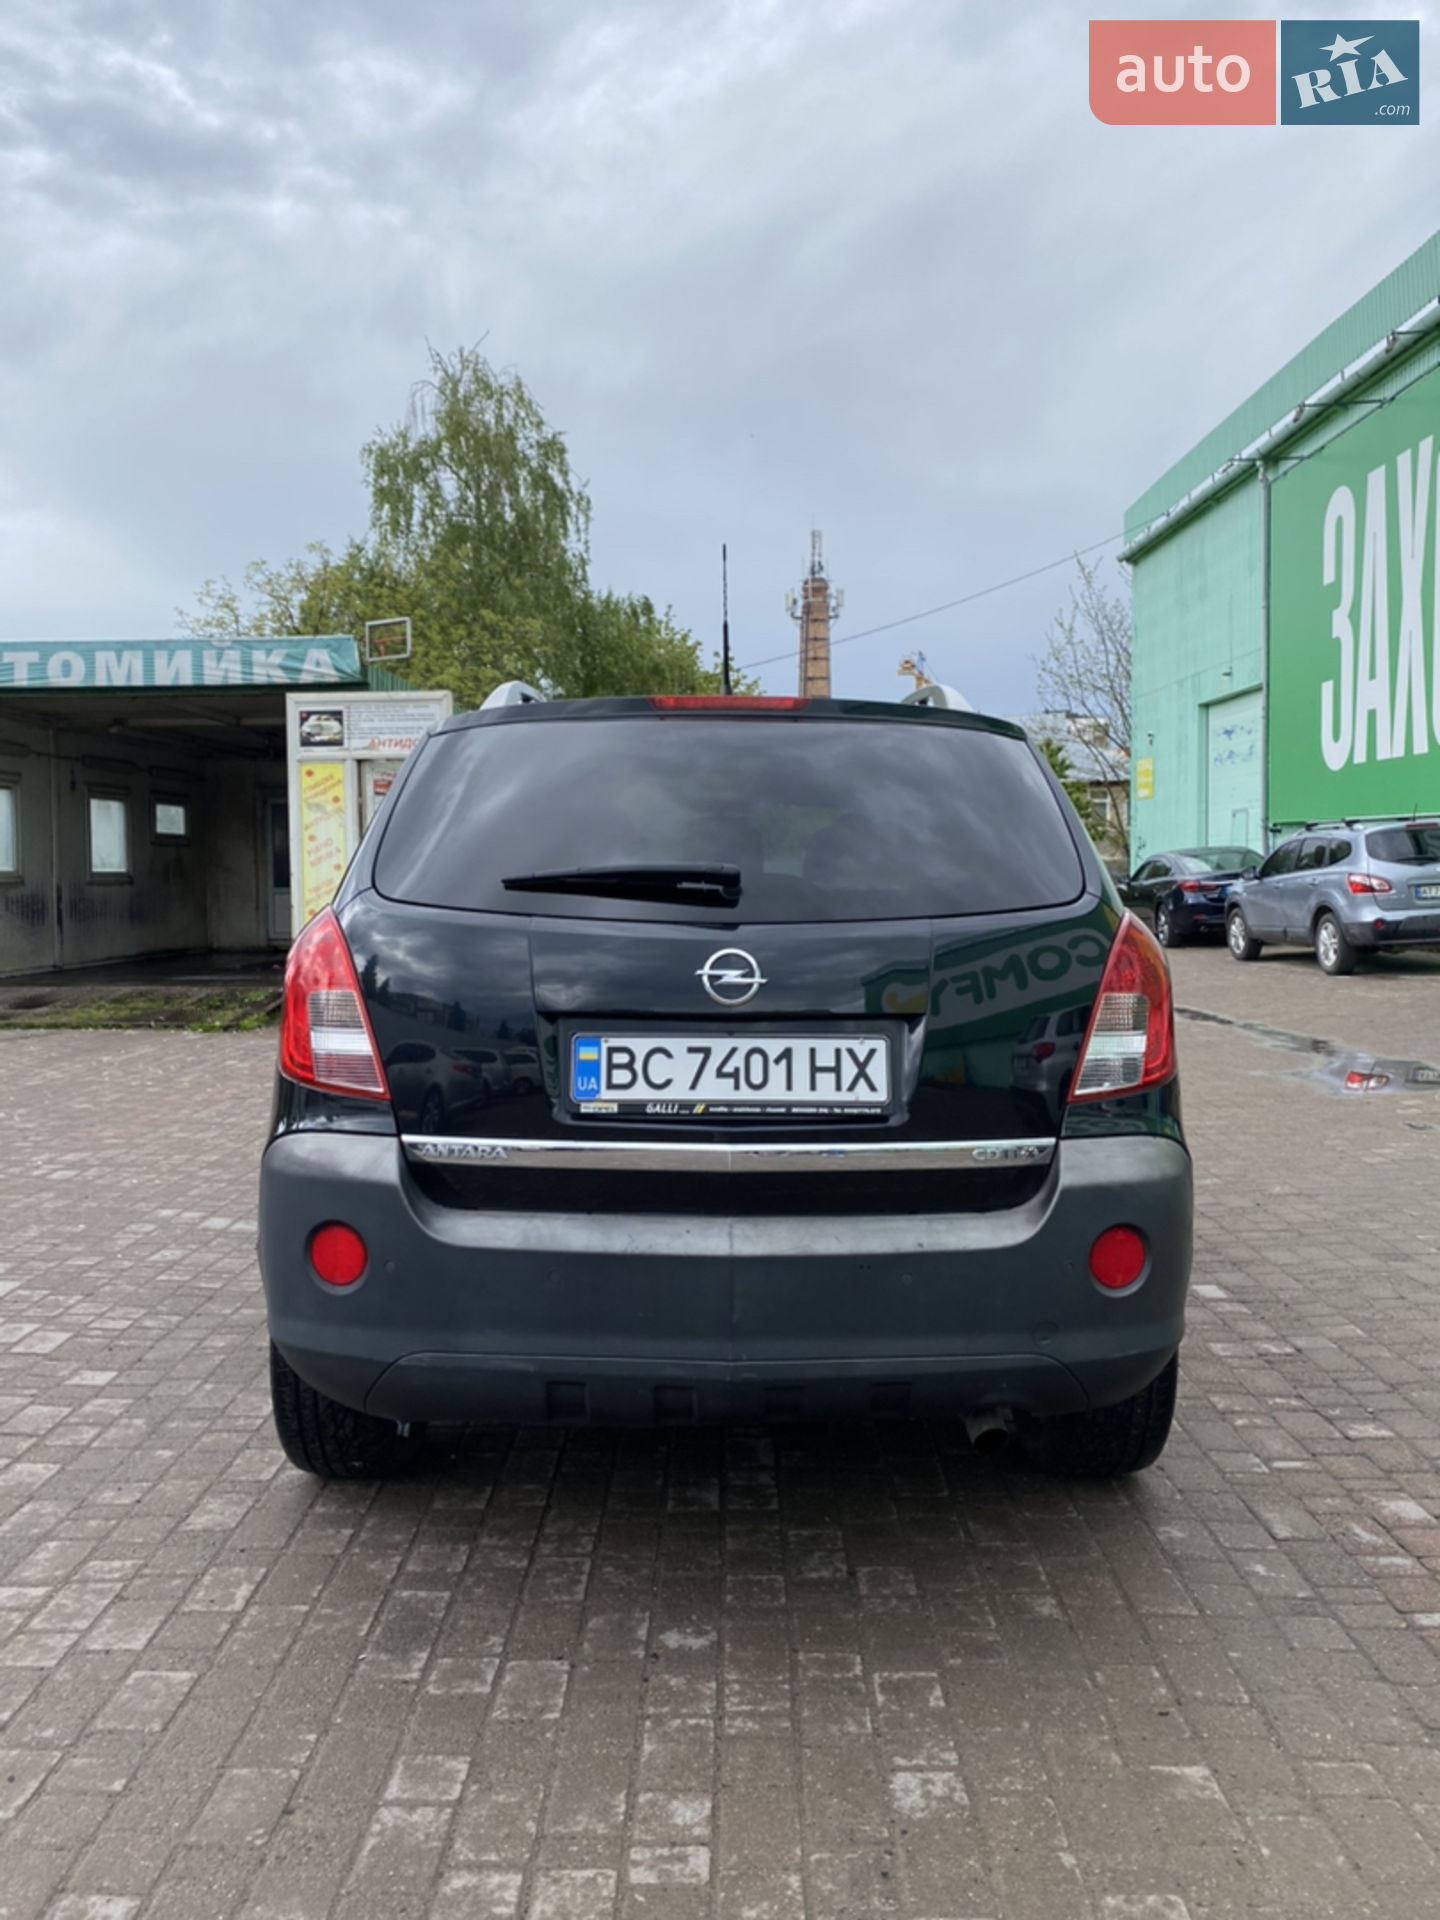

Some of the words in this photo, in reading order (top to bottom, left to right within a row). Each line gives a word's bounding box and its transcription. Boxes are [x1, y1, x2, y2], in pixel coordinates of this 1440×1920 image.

[1321, 434, 1440, 771] ЗАХ
[577, 1077, 598, 1091] UA
[605, 1046, 674, 1092] BC
[686, 1046, 793, 1092] 7401
[809, 1047, 879, 1092] HX
[421, 1143, 508, 1159] ANTARA
